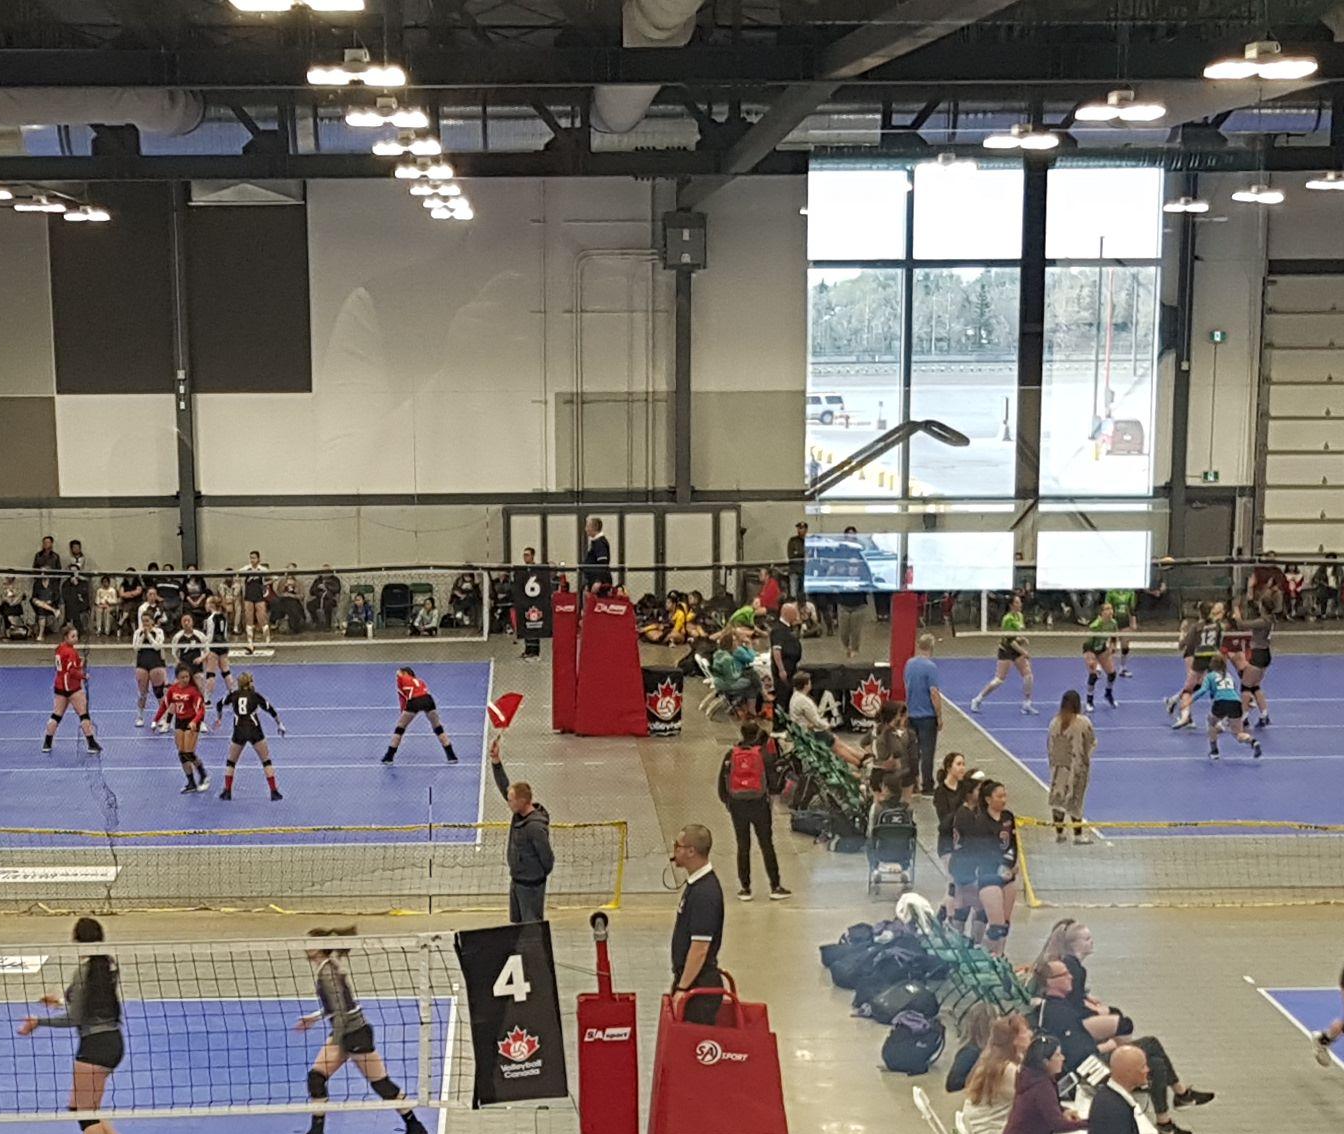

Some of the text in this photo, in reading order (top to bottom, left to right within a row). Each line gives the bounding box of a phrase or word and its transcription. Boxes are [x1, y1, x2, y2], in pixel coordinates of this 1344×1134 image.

[524, 576, 541, 597] 6
[238, 697, 248, 715] 8
[492, 954, 531, 1002] 4
[500, 1059, 543, 1072] Volleyball
[504, 1068, 541, 1079] Canada
